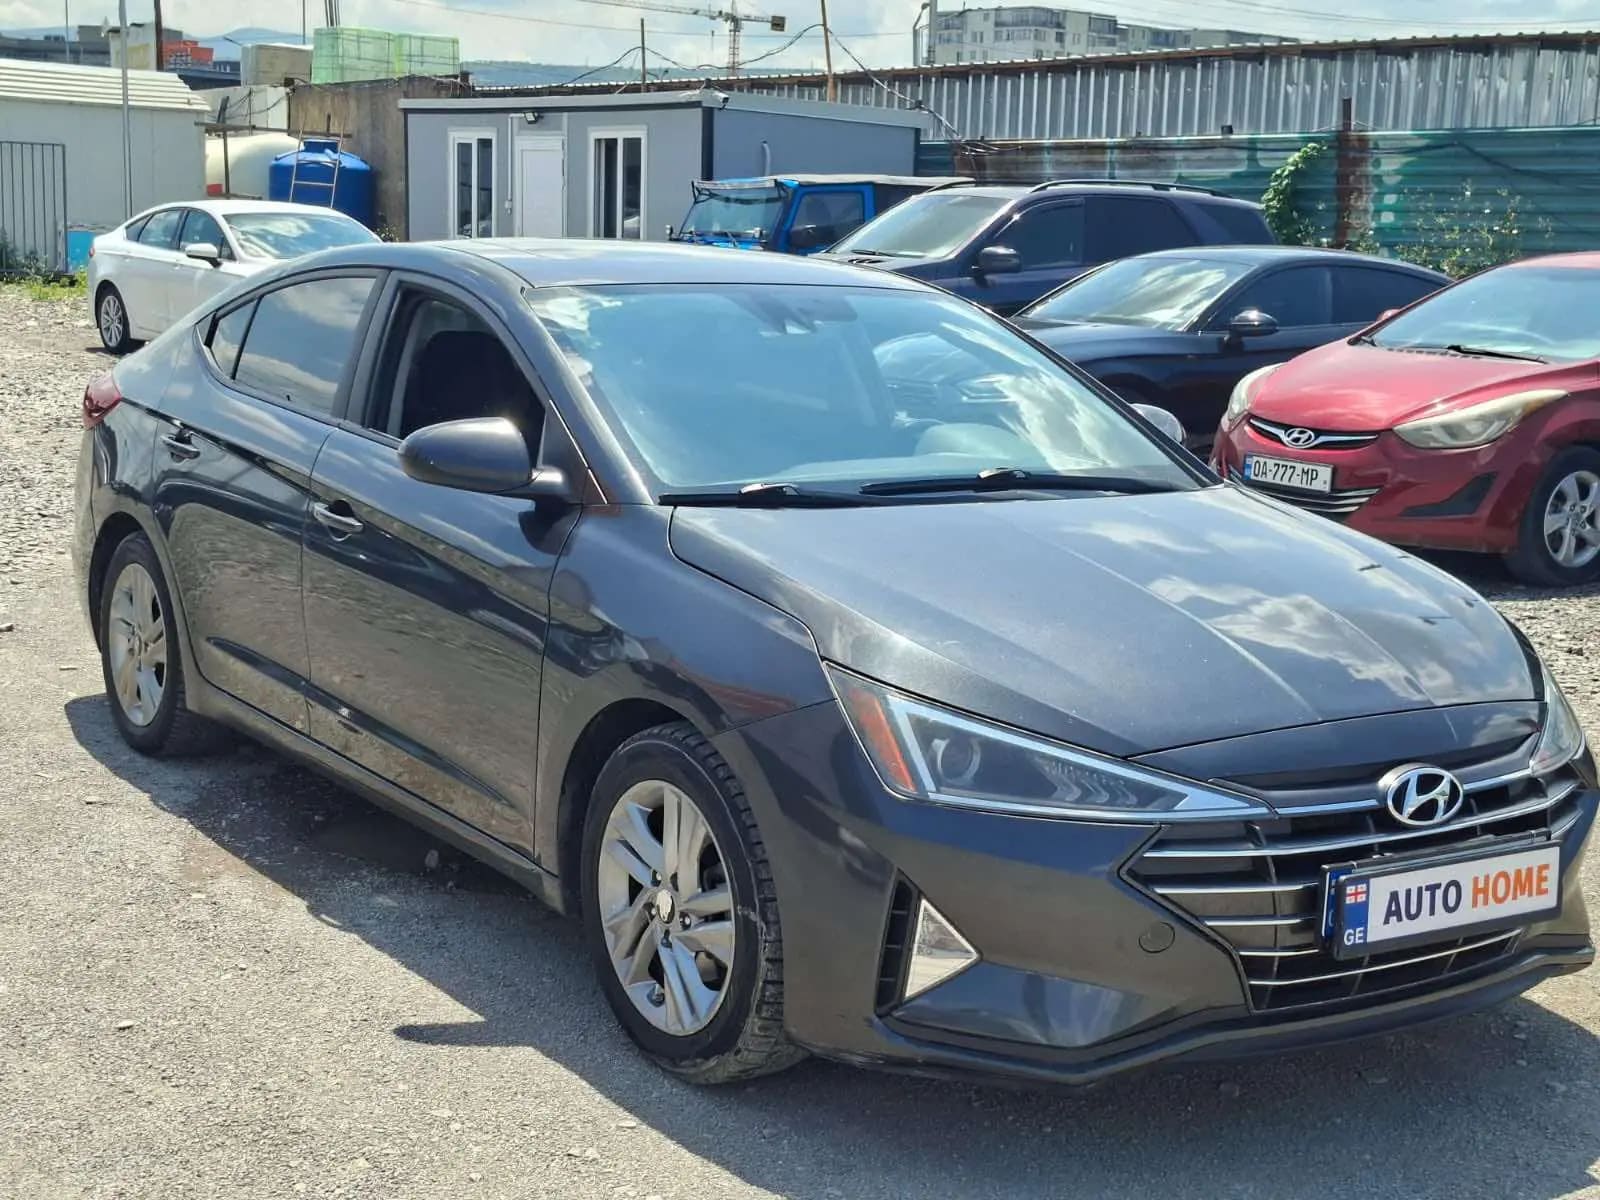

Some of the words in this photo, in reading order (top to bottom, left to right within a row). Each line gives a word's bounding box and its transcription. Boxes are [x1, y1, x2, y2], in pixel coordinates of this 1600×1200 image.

[1383, 880, 1462, 925] AUTO
[1471, 863, 1550, 909] HOME
[1343, 927, 1365, 946] GE
